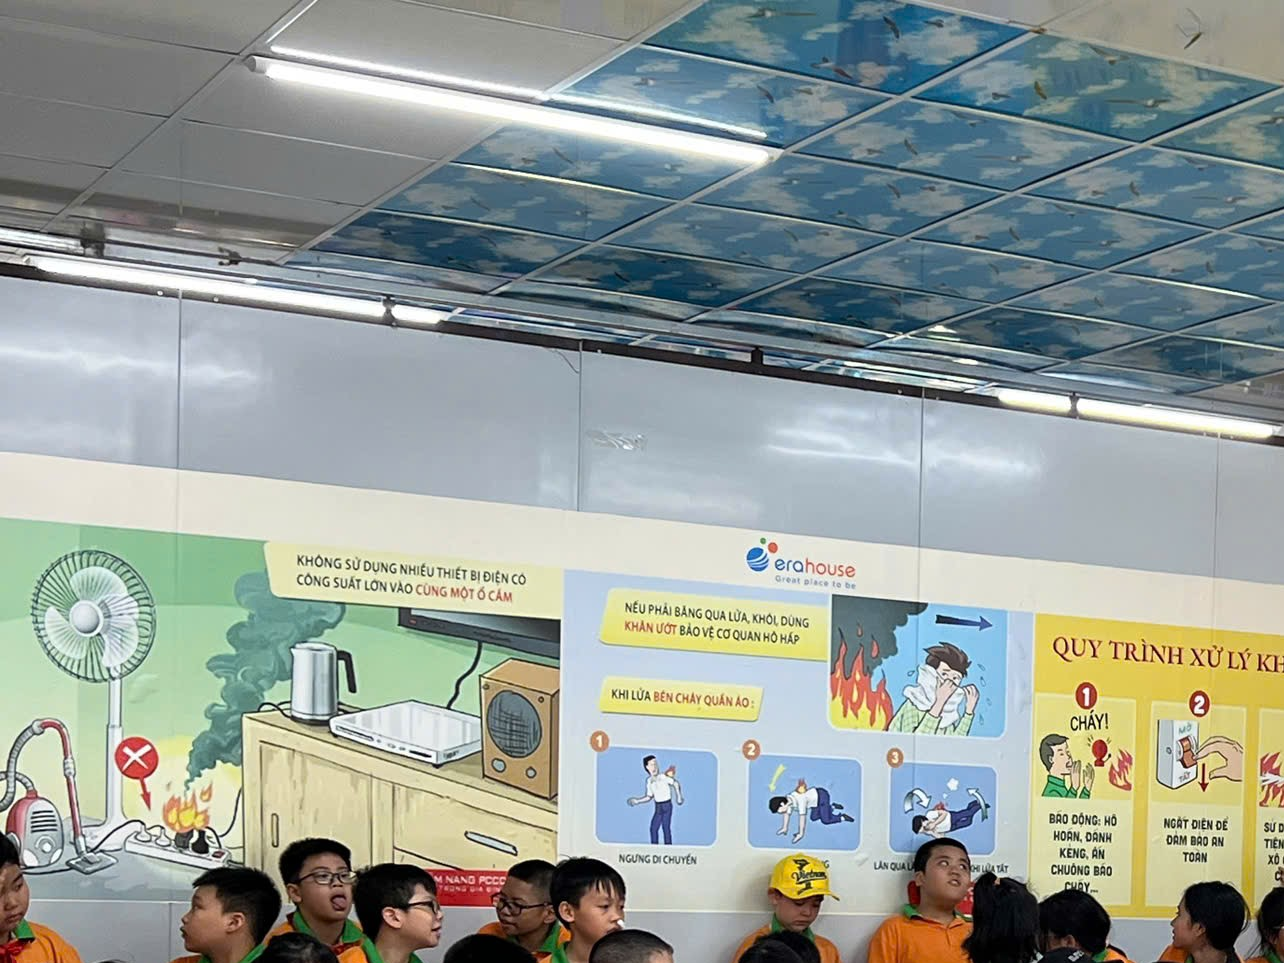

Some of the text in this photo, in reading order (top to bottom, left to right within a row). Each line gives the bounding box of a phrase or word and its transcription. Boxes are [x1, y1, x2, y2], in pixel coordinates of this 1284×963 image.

[297, 555, 342, 569] KHÔNG
[345, 556, 361, 571] SỬ
[364, 561, 398, 574] DỤNG
[437, 567, 467, 580] THIẾT
[470, 570, 481, 583] BỊ
[483, 571, 509, 584] ĐIỆN
[511, 573, 527, 586] CÓ
[774, 557, 856, 578] erahouse
[296, 573, 330, 587] CÔNG
[333, 575, 362, 590] SUẤT
[364, 578, 387, 592] LỚN
[389, 579, 413, 595] VÀO
[415, 583, 448, 598] CÙNG
[450, 586, 475, 601] MỘT
[775, 575, 856, 590] Great place to be
[625, 600, 810, 629] NẾU PHẢI BĂNG QUA LỬA, KHÓI, DÙNG
[656, 621, 677, 635] ƯỚT
[679, 623, 700, 637] BẢO
[702, 625, 715, 640] VỆ
[717, 628, 732, 640] CƠ
[733, 628, 761, 642] QUAN
[1052, 636, 1102, 663] QUY
[1109, 639, 1184, 665] TRÌNH
[1190, 644, 1223, 668] XỬ
[1228, 648, 1253, 670] LÝ
[611, 688, 629, 699] KHI
[631, 688, 651, 701] LỬA
[675, 691, 702, 705] CHÁY
[735, 694, 750, 708] ÁO
[1082, 687, 1090, 706] 1
[1193, 695, 1205, 714] 2
[1070, 710, 1109, 731] CHÁY!
[595, 735, 603, 747] 1
[747, 744, 755, 756] 2
[892, 751, 899, 764] 3
[1049, 810, 1068, 824] BÁO
[1072, 812, 1101, 827] ĐỘNG:
[1191, 818, 1213, 832] ĐIỆN
[1215, 816, 1229, 831] ĐỂ
[1085, 828, 1112, 843] ĐÁNH
[1166, 830, 1224, 847] ĐẢM BẢO AN
[1264, 837, 1284, 851] TIỆN
[652, 855, 661, 864] DI
[1183, 848, 1208, 863] TOÀN
[1268, 853, 1280, 865] XÔ
[890, 862, 905, 871] QUA
[1051, 863, 1112, 876] CHUÔNG BÁO
[479, 876, 507, 885] PCCC
